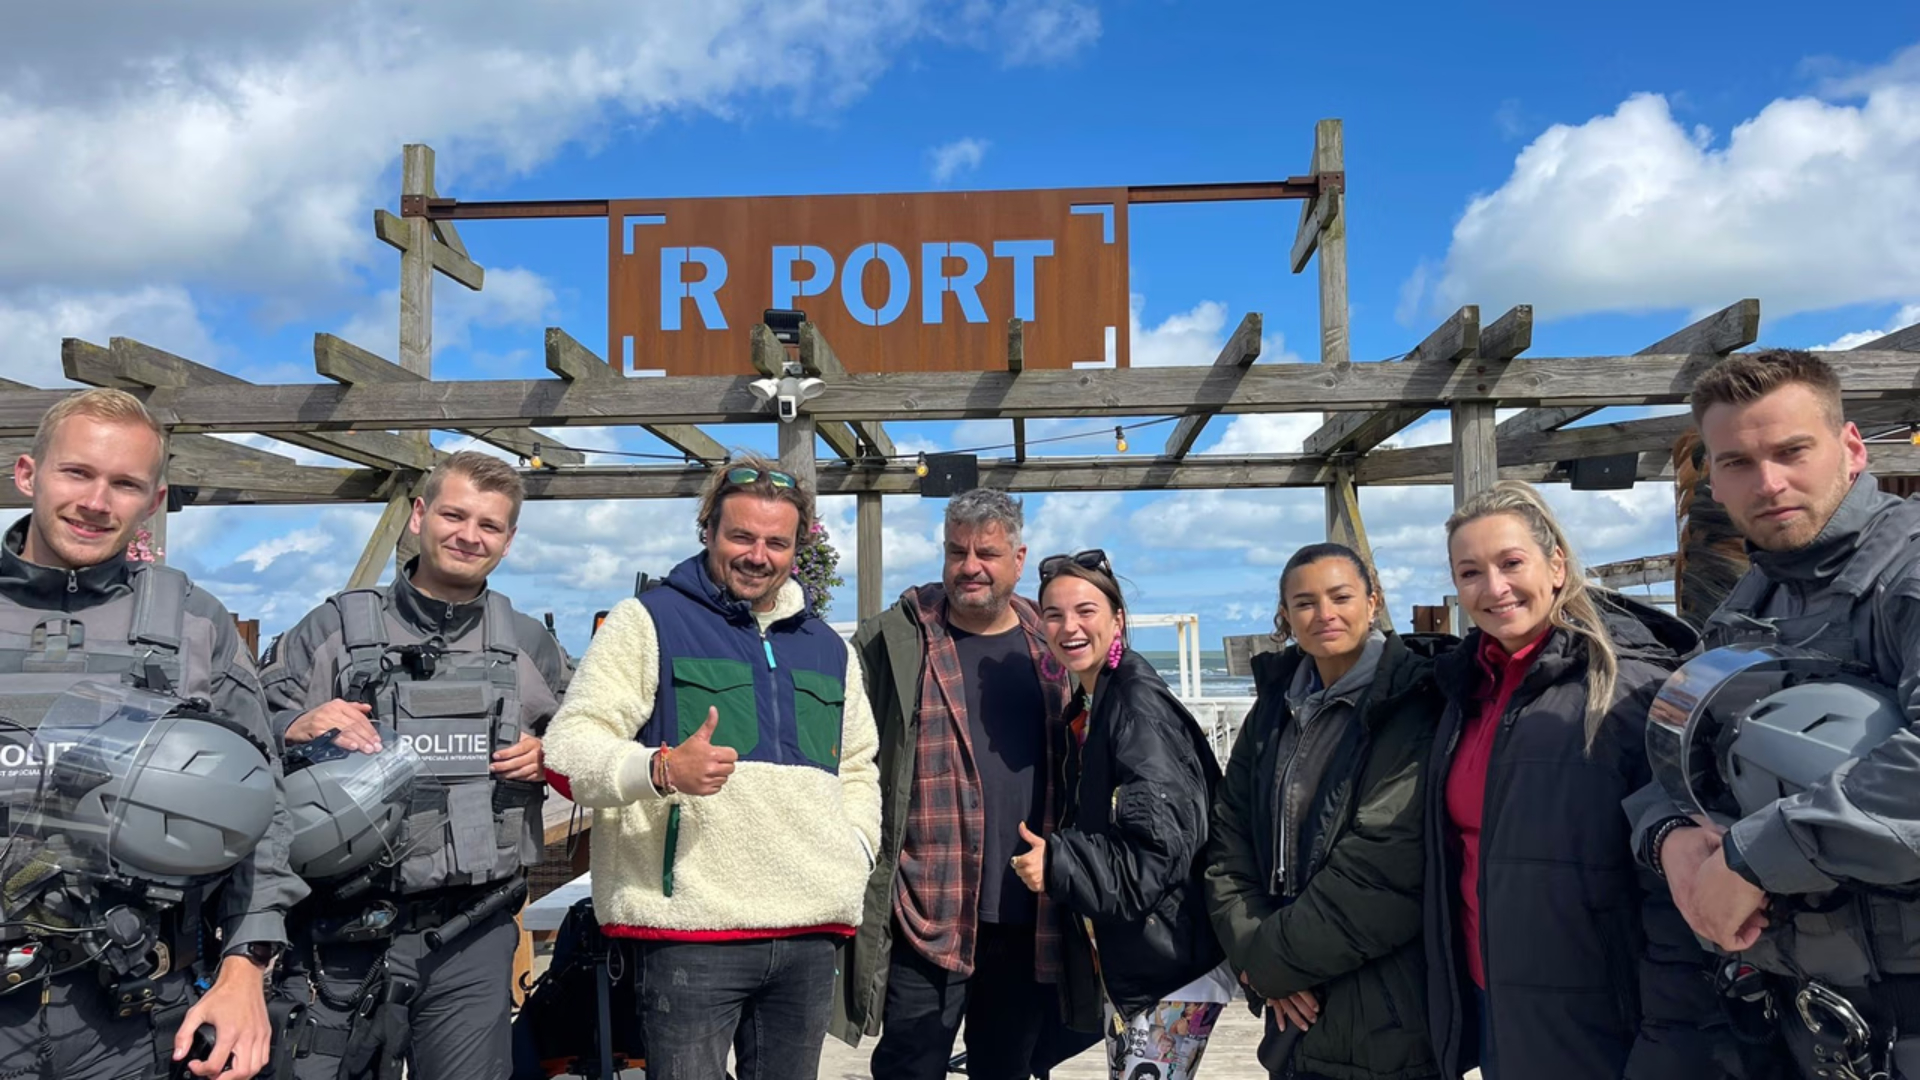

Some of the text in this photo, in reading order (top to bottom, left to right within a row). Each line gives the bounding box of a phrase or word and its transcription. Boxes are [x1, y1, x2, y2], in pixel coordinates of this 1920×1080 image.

[660, 239, 1054, 331] R PORT
[400, 734, 488, 754] POLITIE
